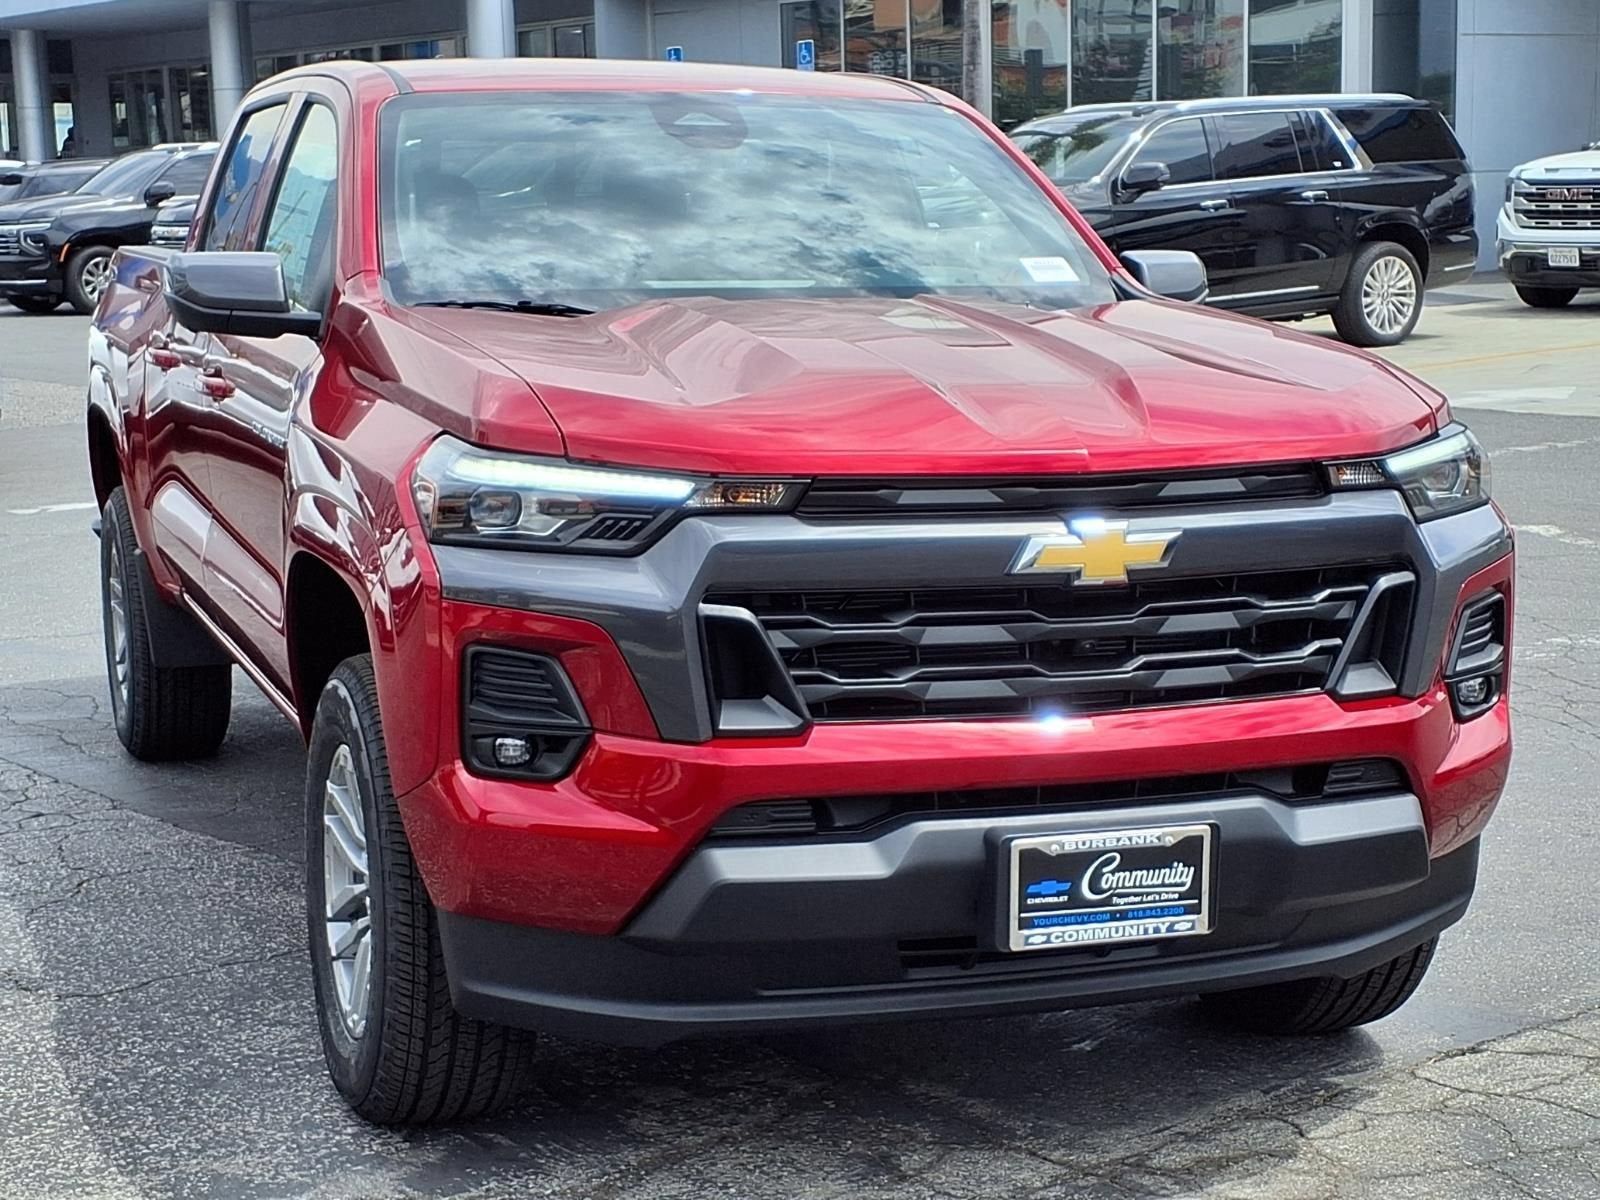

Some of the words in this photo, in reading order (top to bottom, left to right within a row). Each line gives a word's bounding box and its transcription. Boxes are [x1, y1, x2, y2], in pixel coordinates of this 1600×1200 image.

[1545, 188, 1593, 200] GMC
[1064, 833, 1160, 850] BURBANK
[1081, 852, 1195, 900] Community
[1026, 895, 1069, 904] CHEVROLET
[1112, 895, 1142, 904] Together
[1033, 912, 1111, 926] YOURCHEVY.COM
[1128, 907, 1184, 918] 818.843.2200
[1050, 922, 1170, 943] COMMUNITY
